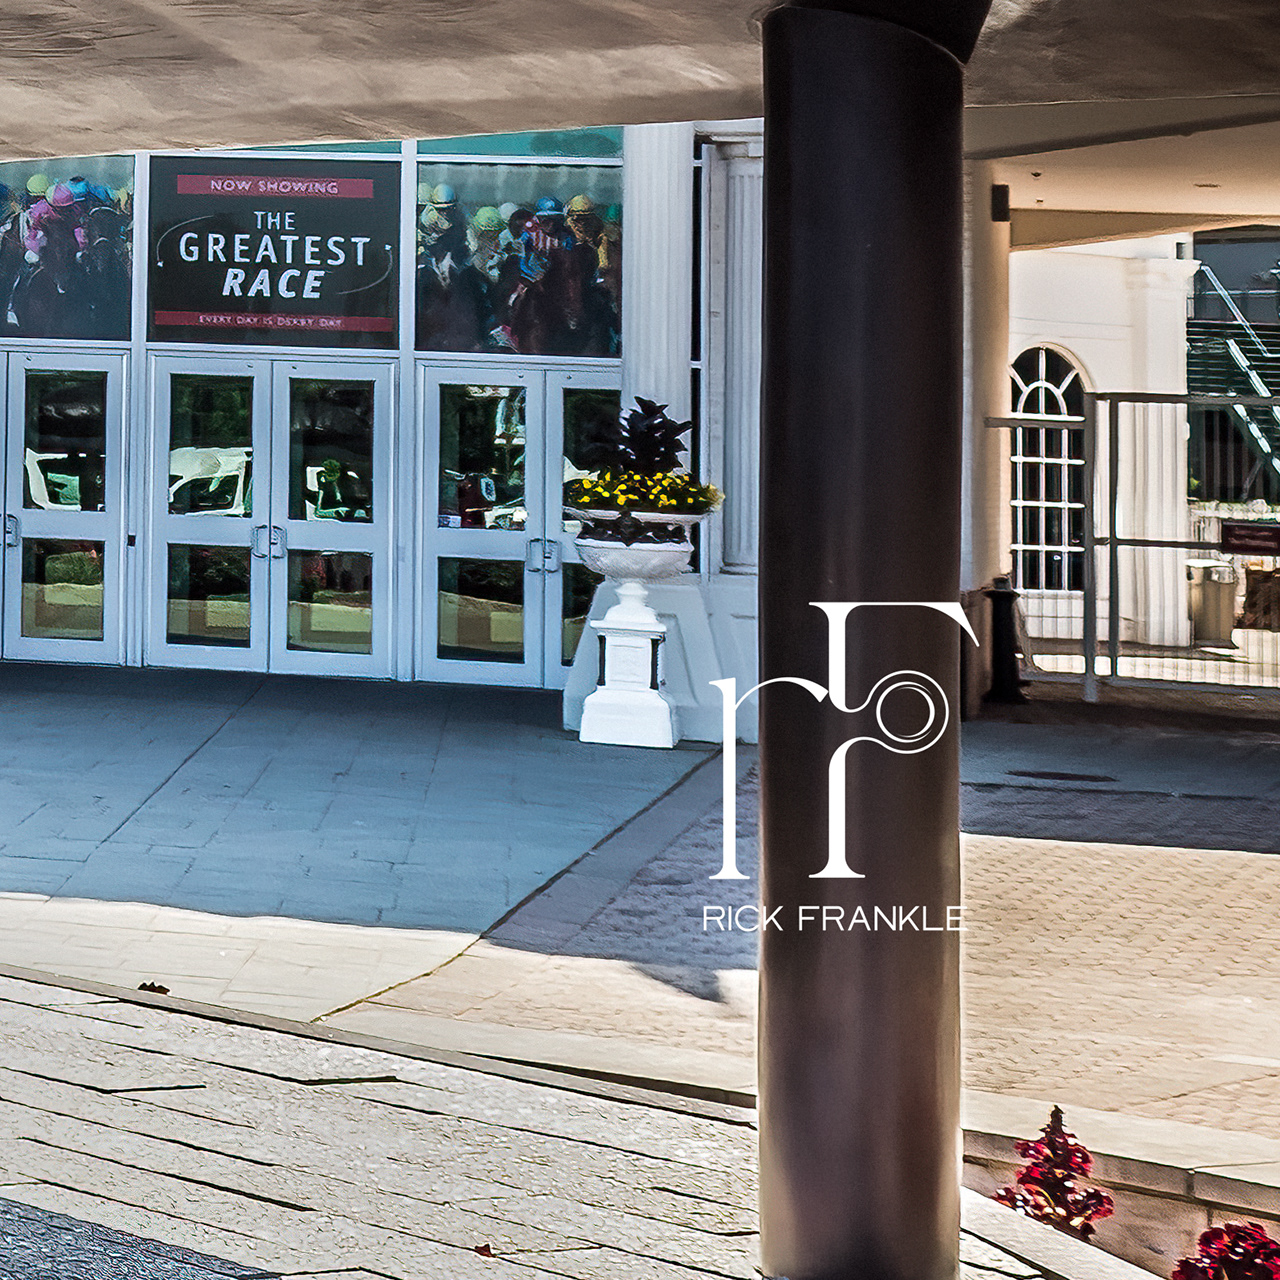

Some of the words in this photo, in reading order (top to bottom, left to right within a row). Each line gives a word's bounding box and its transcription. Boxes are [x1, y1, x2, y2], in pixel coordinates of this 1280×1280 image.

[210, 179, 253, 193] NOW
[258, 181, 339, 195] SHOWING
[253, 210, 296, 231] THE
[179, 232, 371, 266] GREATEST
[222, 268, 326, 299] RACE
